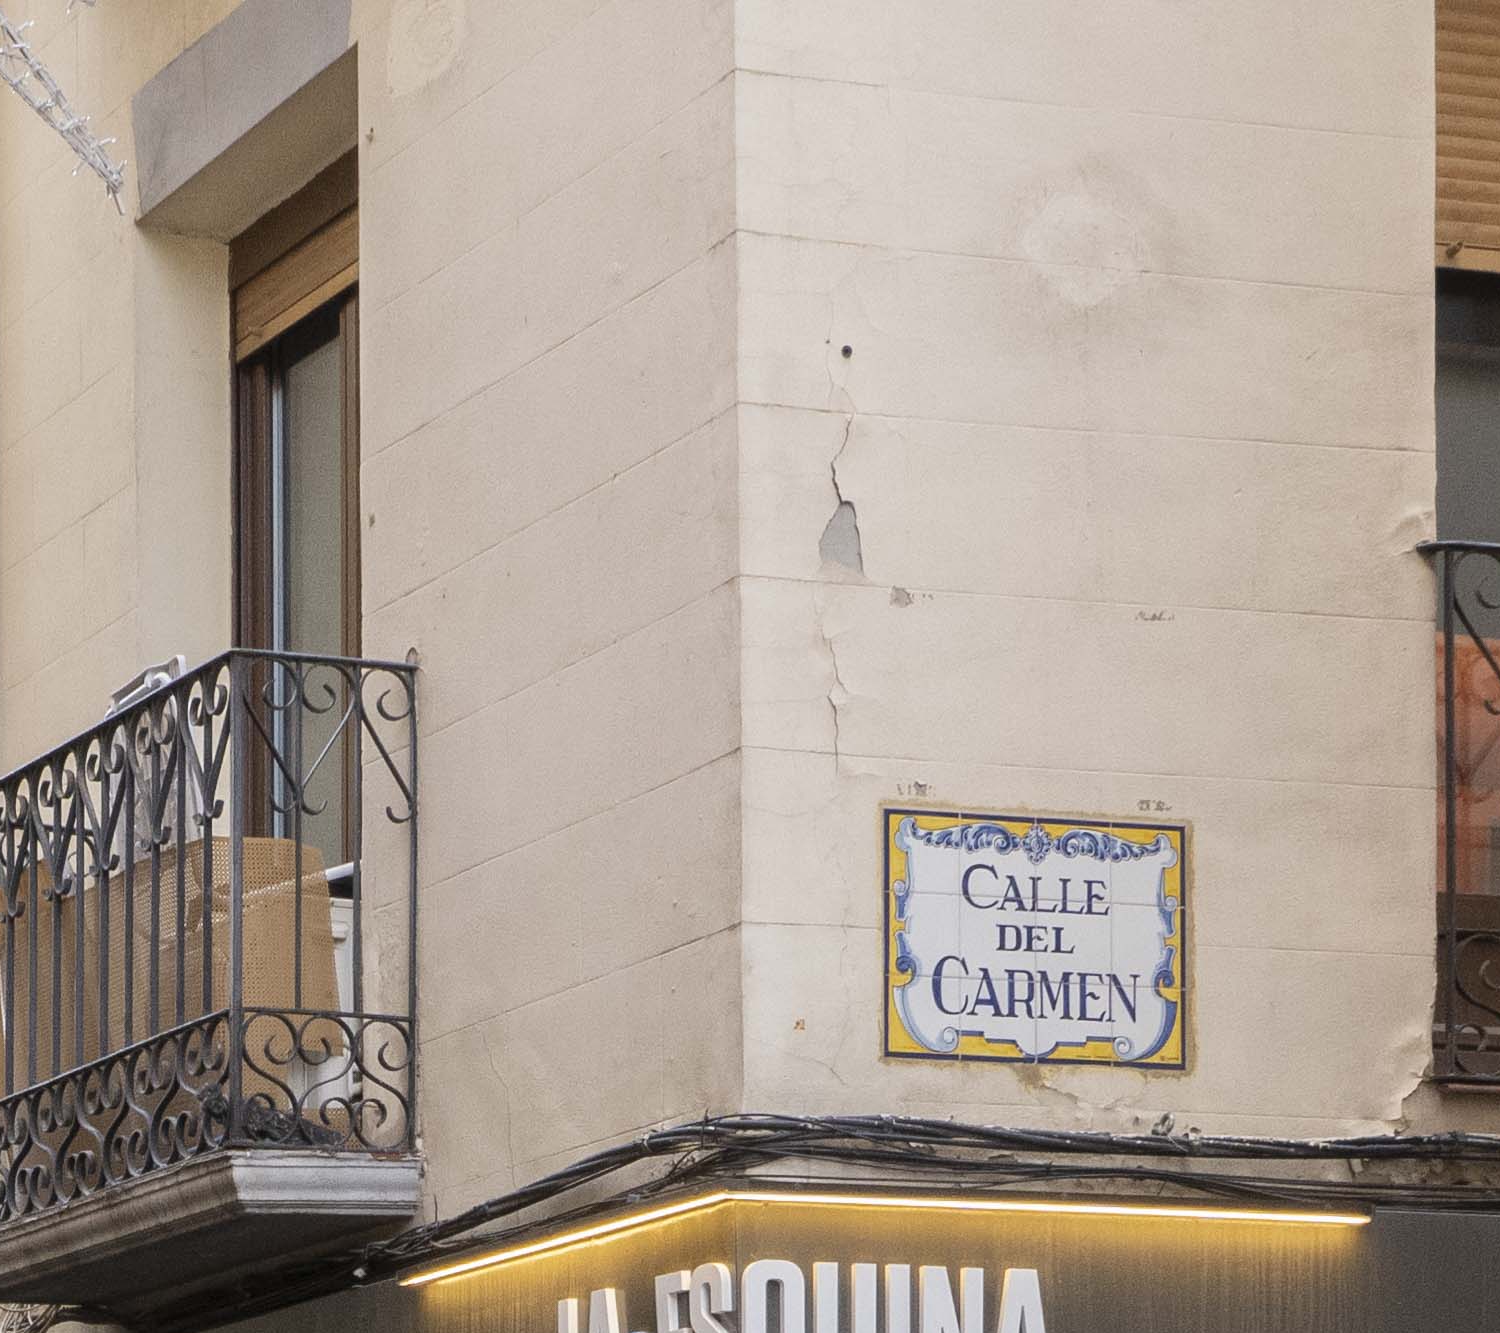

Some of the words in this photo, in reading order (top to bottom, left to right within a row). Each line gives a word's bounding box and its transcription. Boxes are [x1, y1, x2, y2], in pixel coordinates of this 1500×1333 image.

[961, 863, 1110, 916] CALLE
[995, 924, 1076, 954] DEL
[931, 955, 1141, 1023] CARMEN
